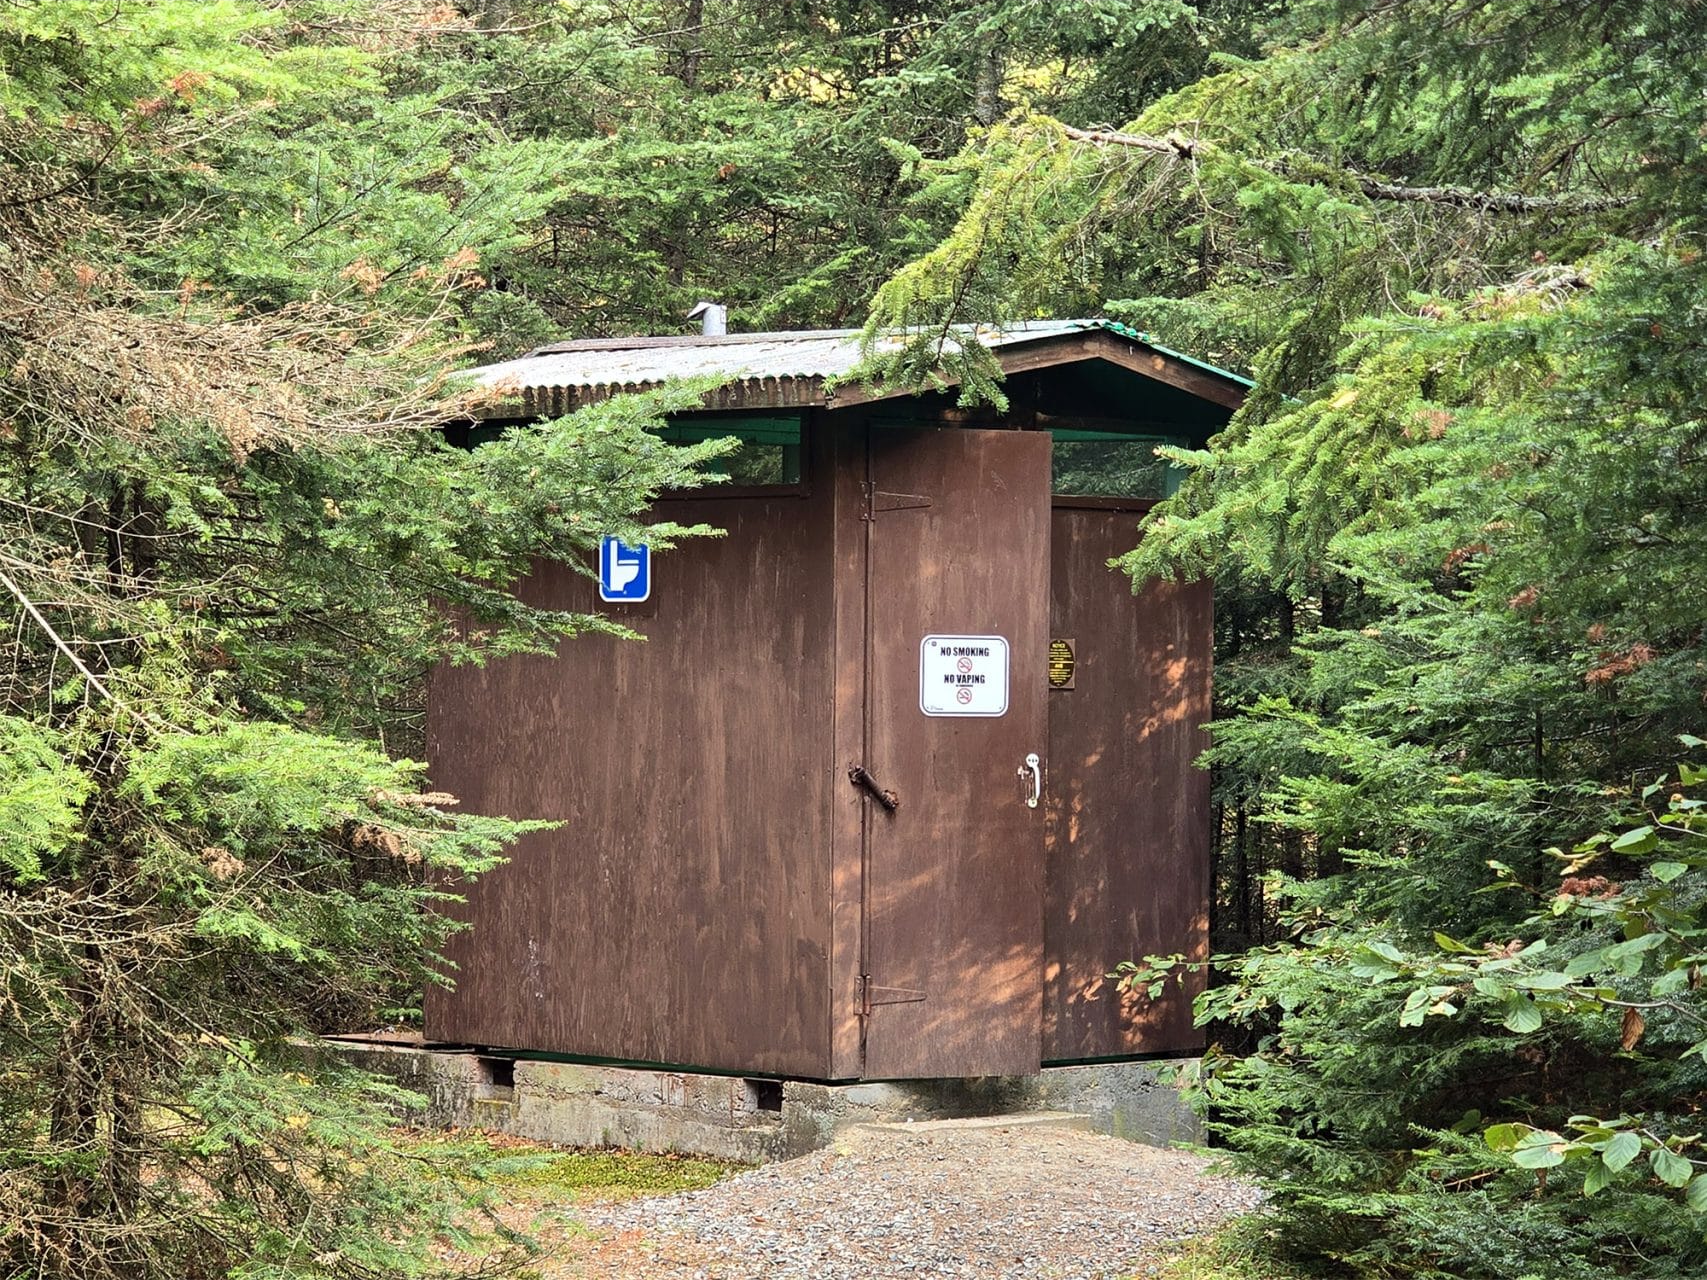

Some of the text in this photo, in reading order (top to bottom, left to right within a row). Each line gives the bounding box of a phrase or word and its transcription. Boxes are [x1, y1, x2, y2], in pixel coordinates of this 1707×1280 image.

[940, 647, 989, 657] NO SMOKING
[944, 674, 986, 684] NO VAPING
